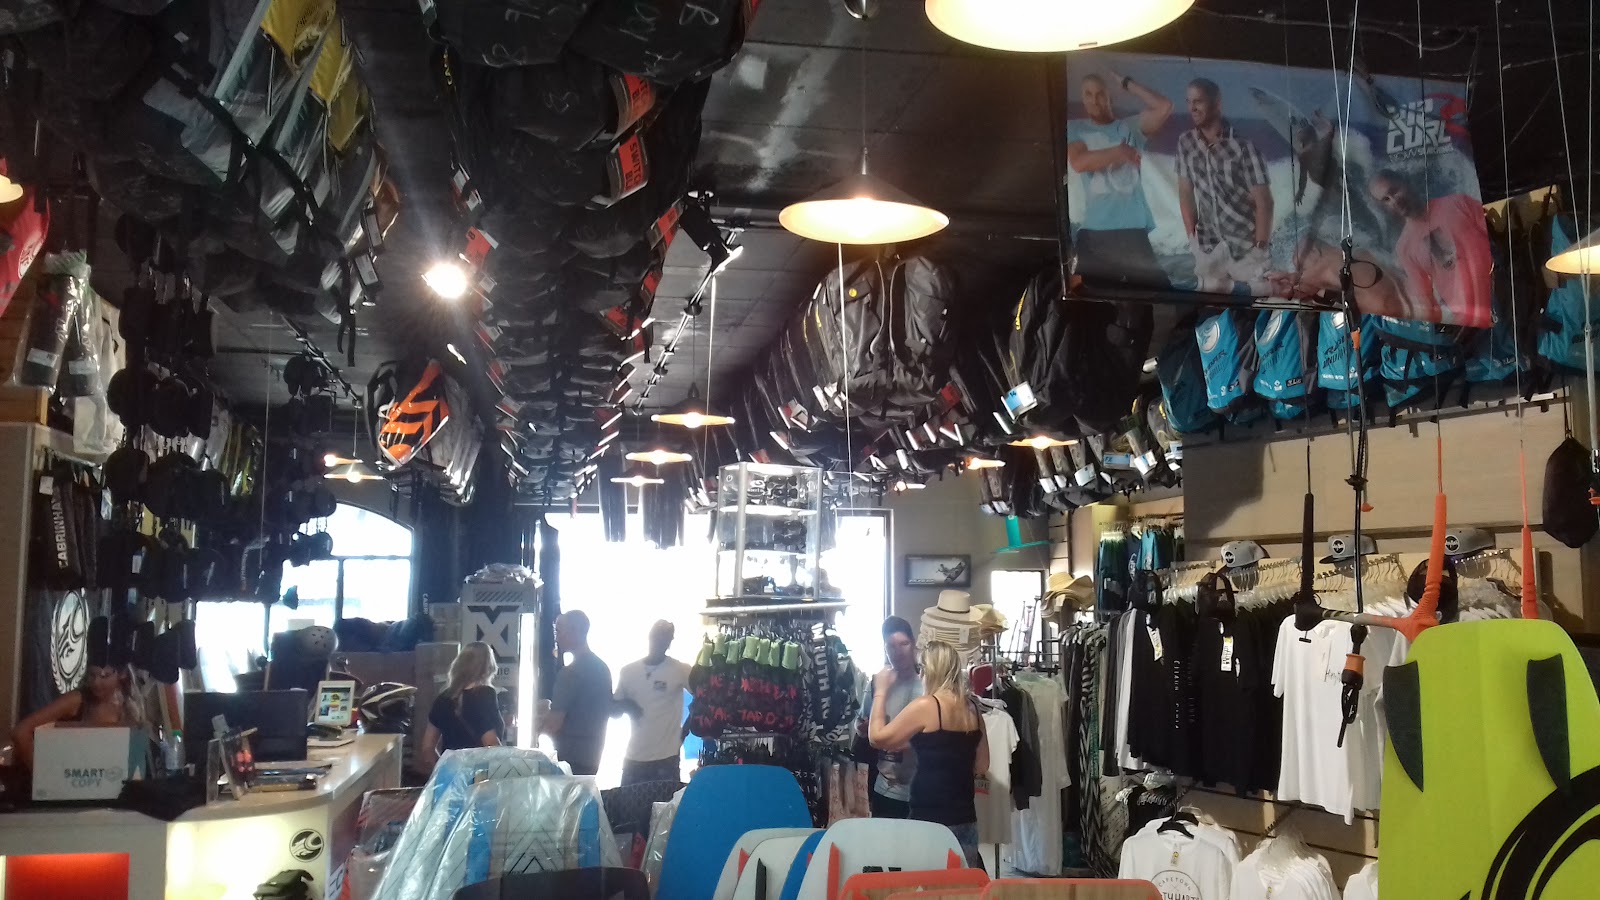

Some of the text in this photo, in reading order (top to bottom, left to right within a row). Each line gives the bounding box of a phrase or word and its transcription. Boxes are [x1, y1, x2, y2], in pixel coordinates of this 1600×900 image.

[1386, 118, 1451, 155] CURL
[51, 501, 68, 569] CABRINHA
[64, 768, 104, 778] SMART
[71, 779, 101, 788] COPY
